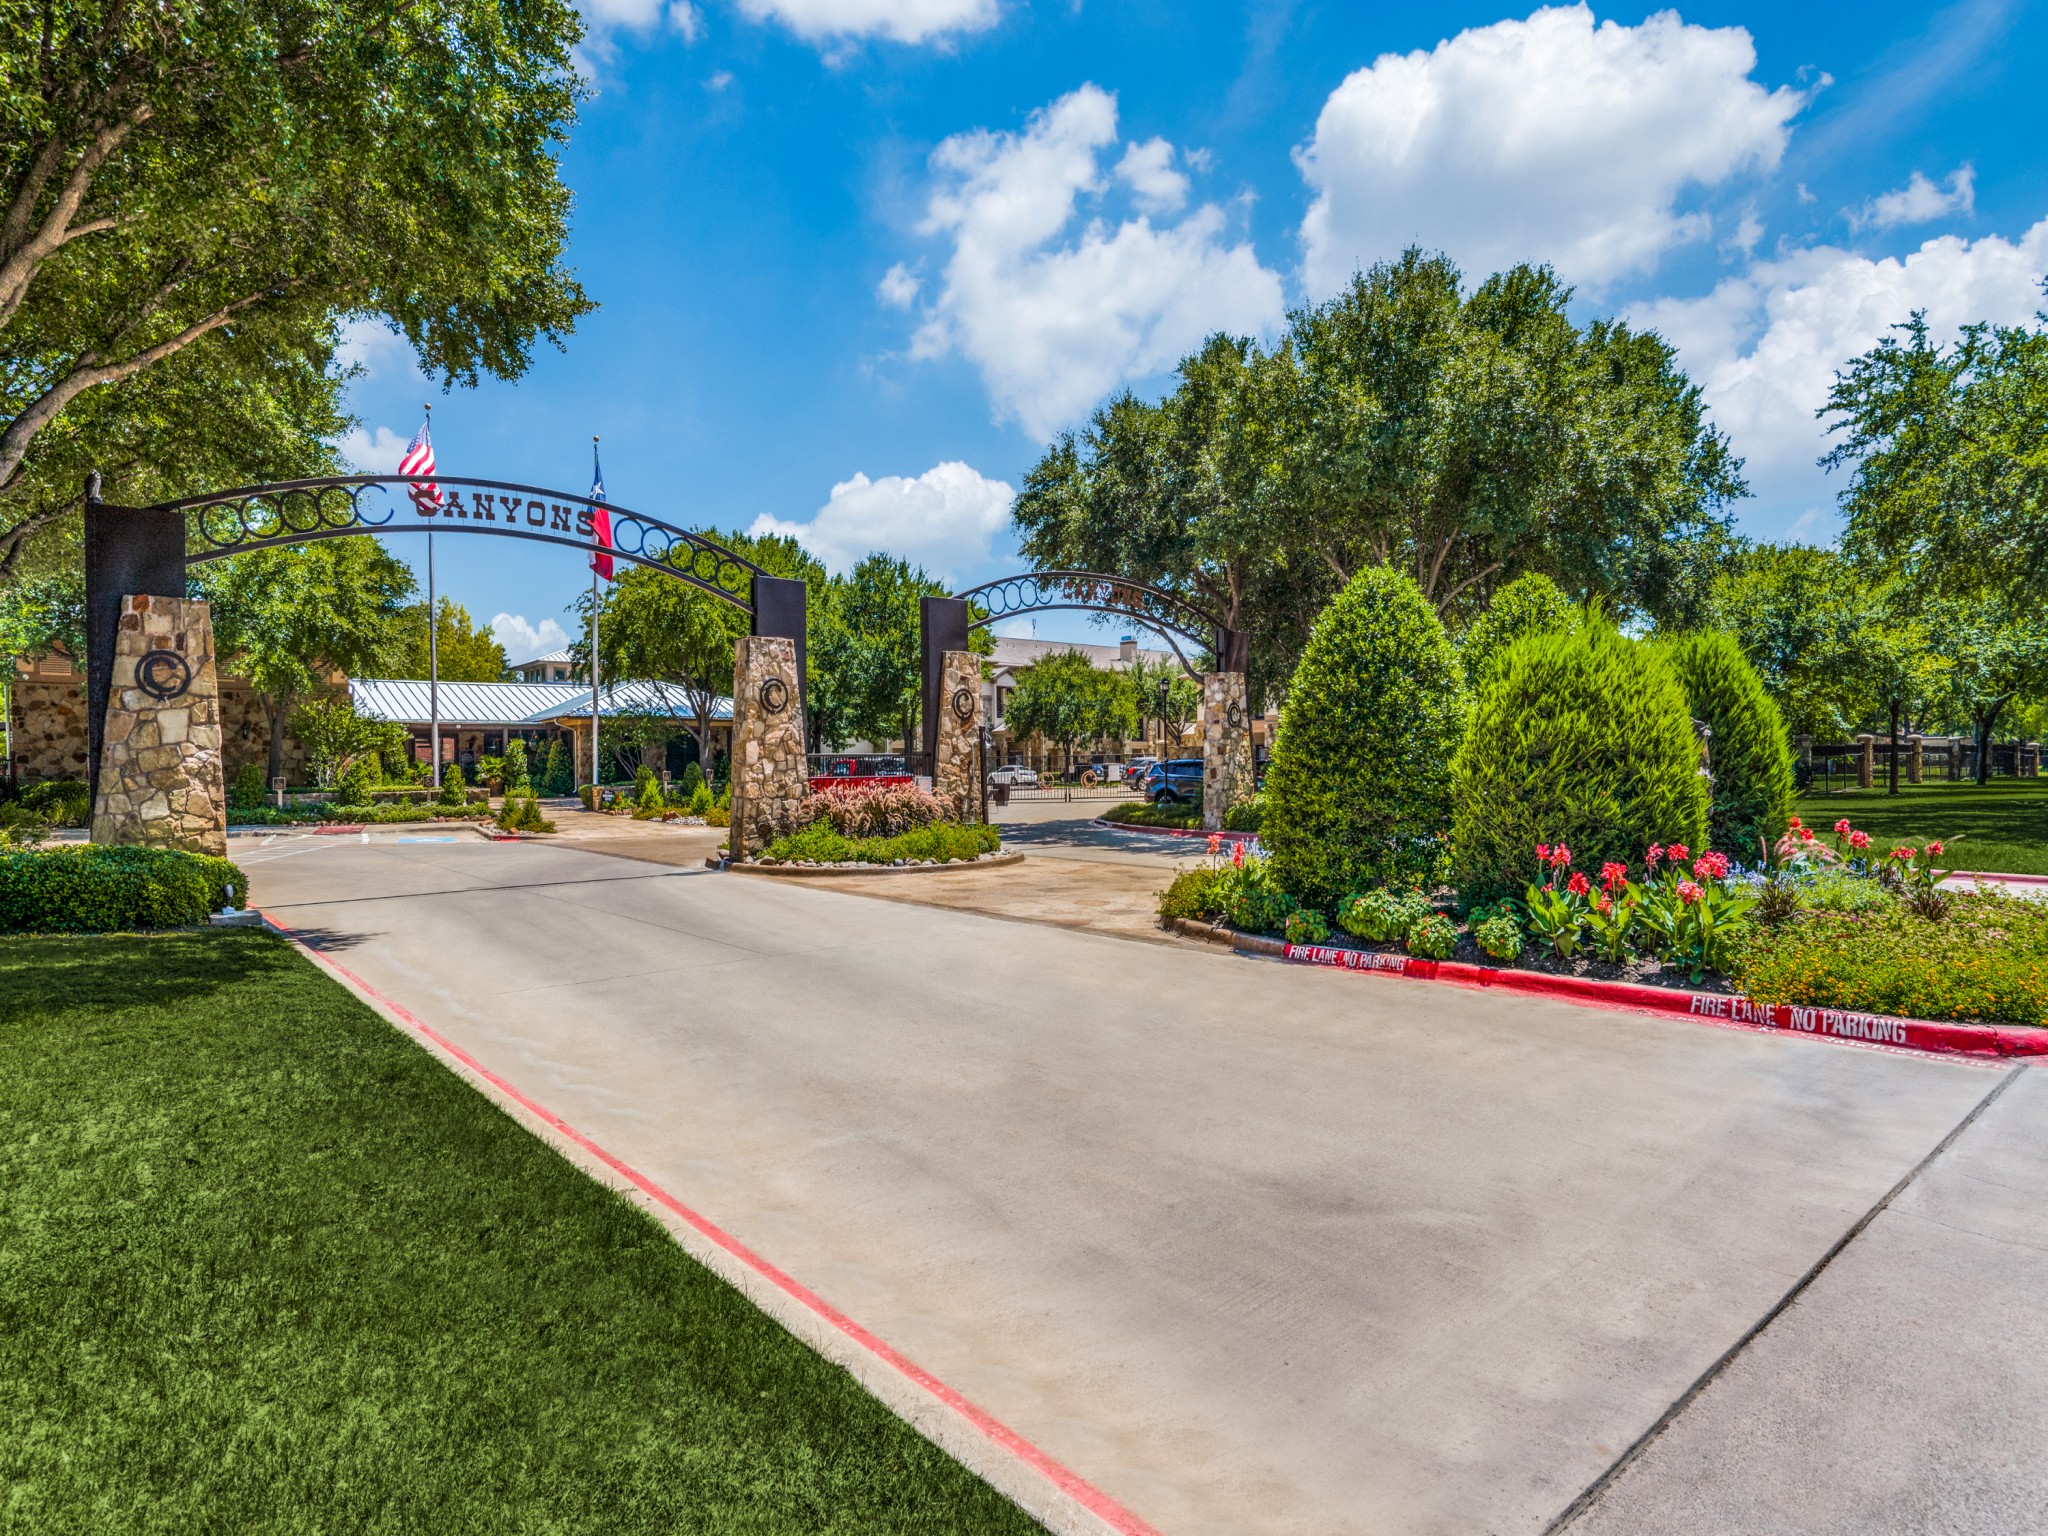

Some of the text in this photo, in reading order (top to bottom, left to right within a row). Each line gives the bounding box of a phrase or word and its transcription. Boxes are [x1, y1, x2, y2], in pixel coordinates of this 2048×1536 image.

[413, 489, 596, 537] CANYONS
[1289, 945, 1405, 971] FIRE LANE NO PARKING
[1690, 995, 1906, 1044] FIRE LANE NO PARKING
